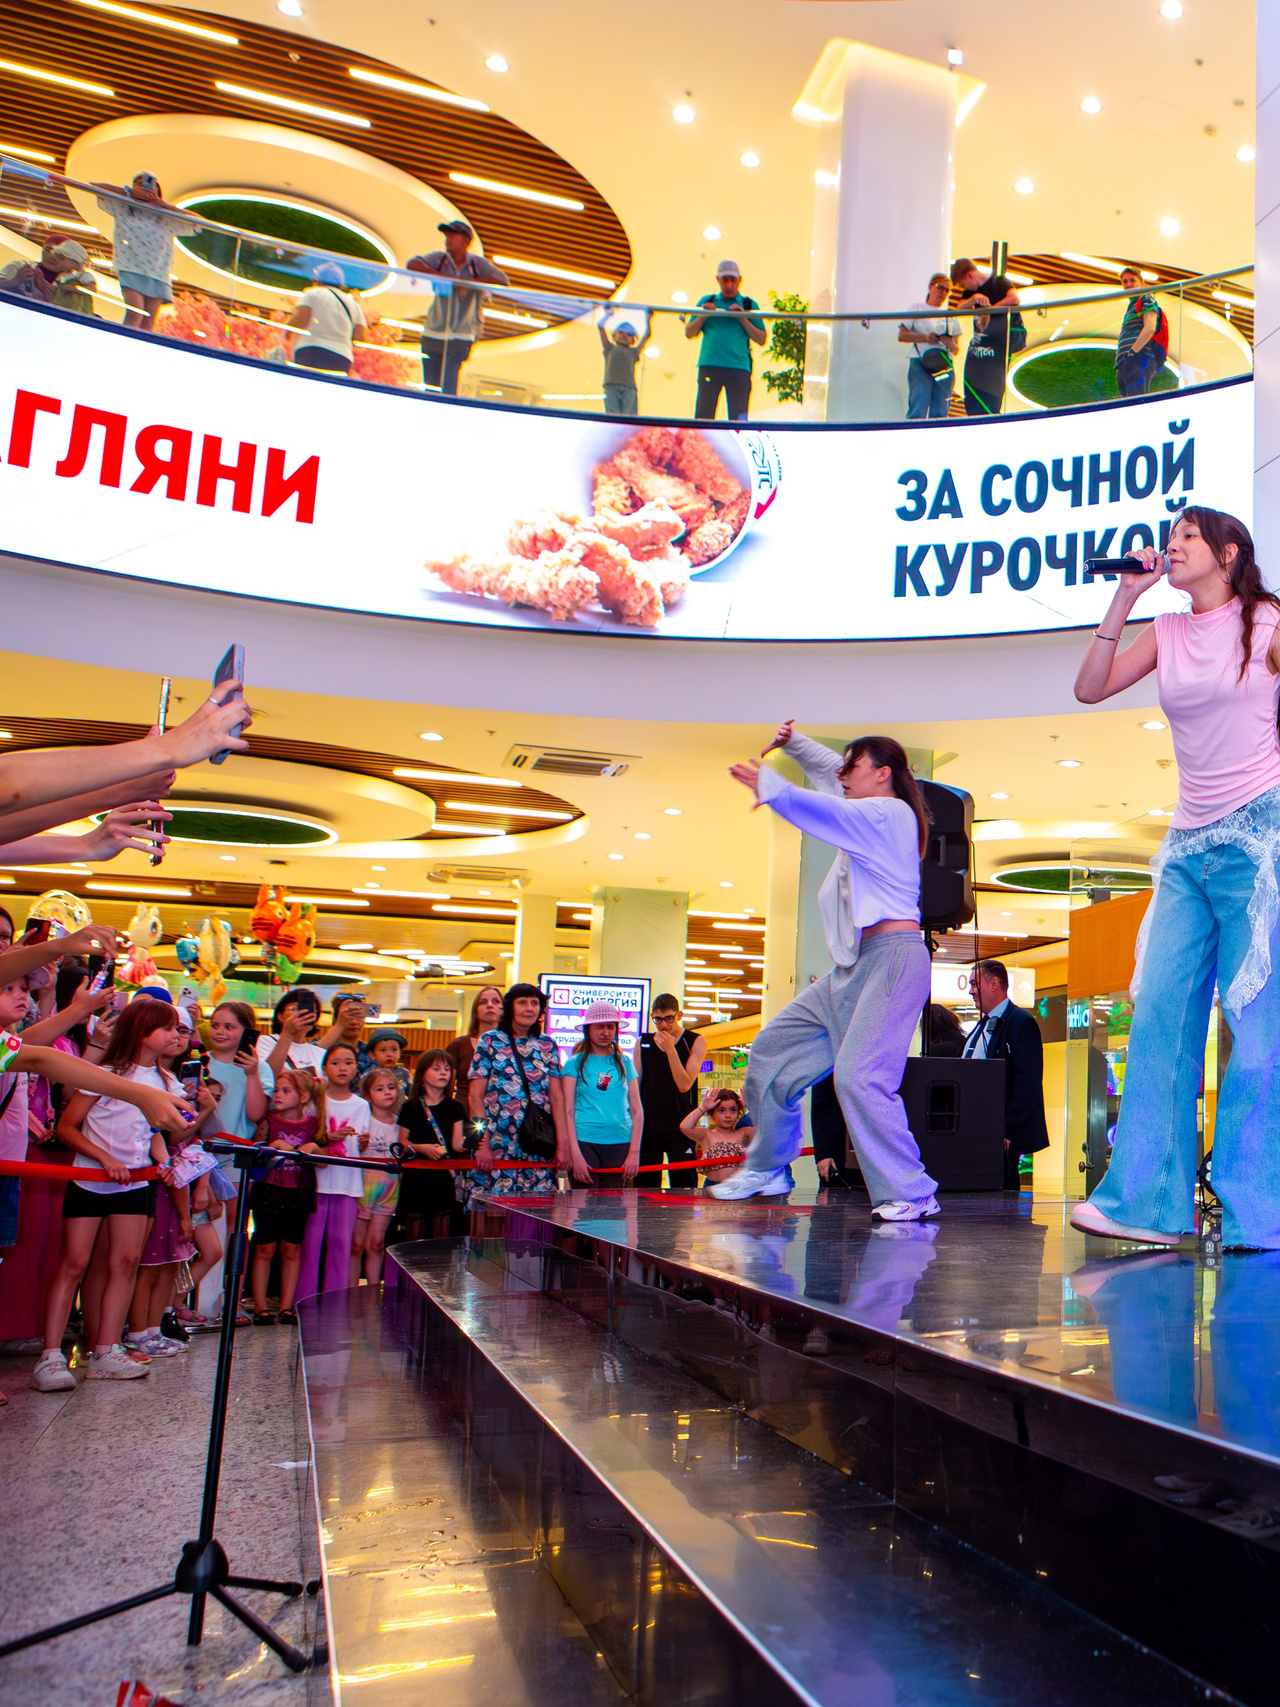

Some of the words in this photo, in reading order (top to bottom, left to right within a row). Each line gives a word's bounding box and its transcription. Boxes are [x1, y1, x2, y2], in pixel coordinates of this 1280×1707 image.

[0, 388, 320, 524] ГЛЯНИ
[894, 468, 964, 522] ЗА
[979, 418, 1195, 517] СОЧНОЙ
[573, 988, 638, 998] УНИВЕРСИТЕТ
